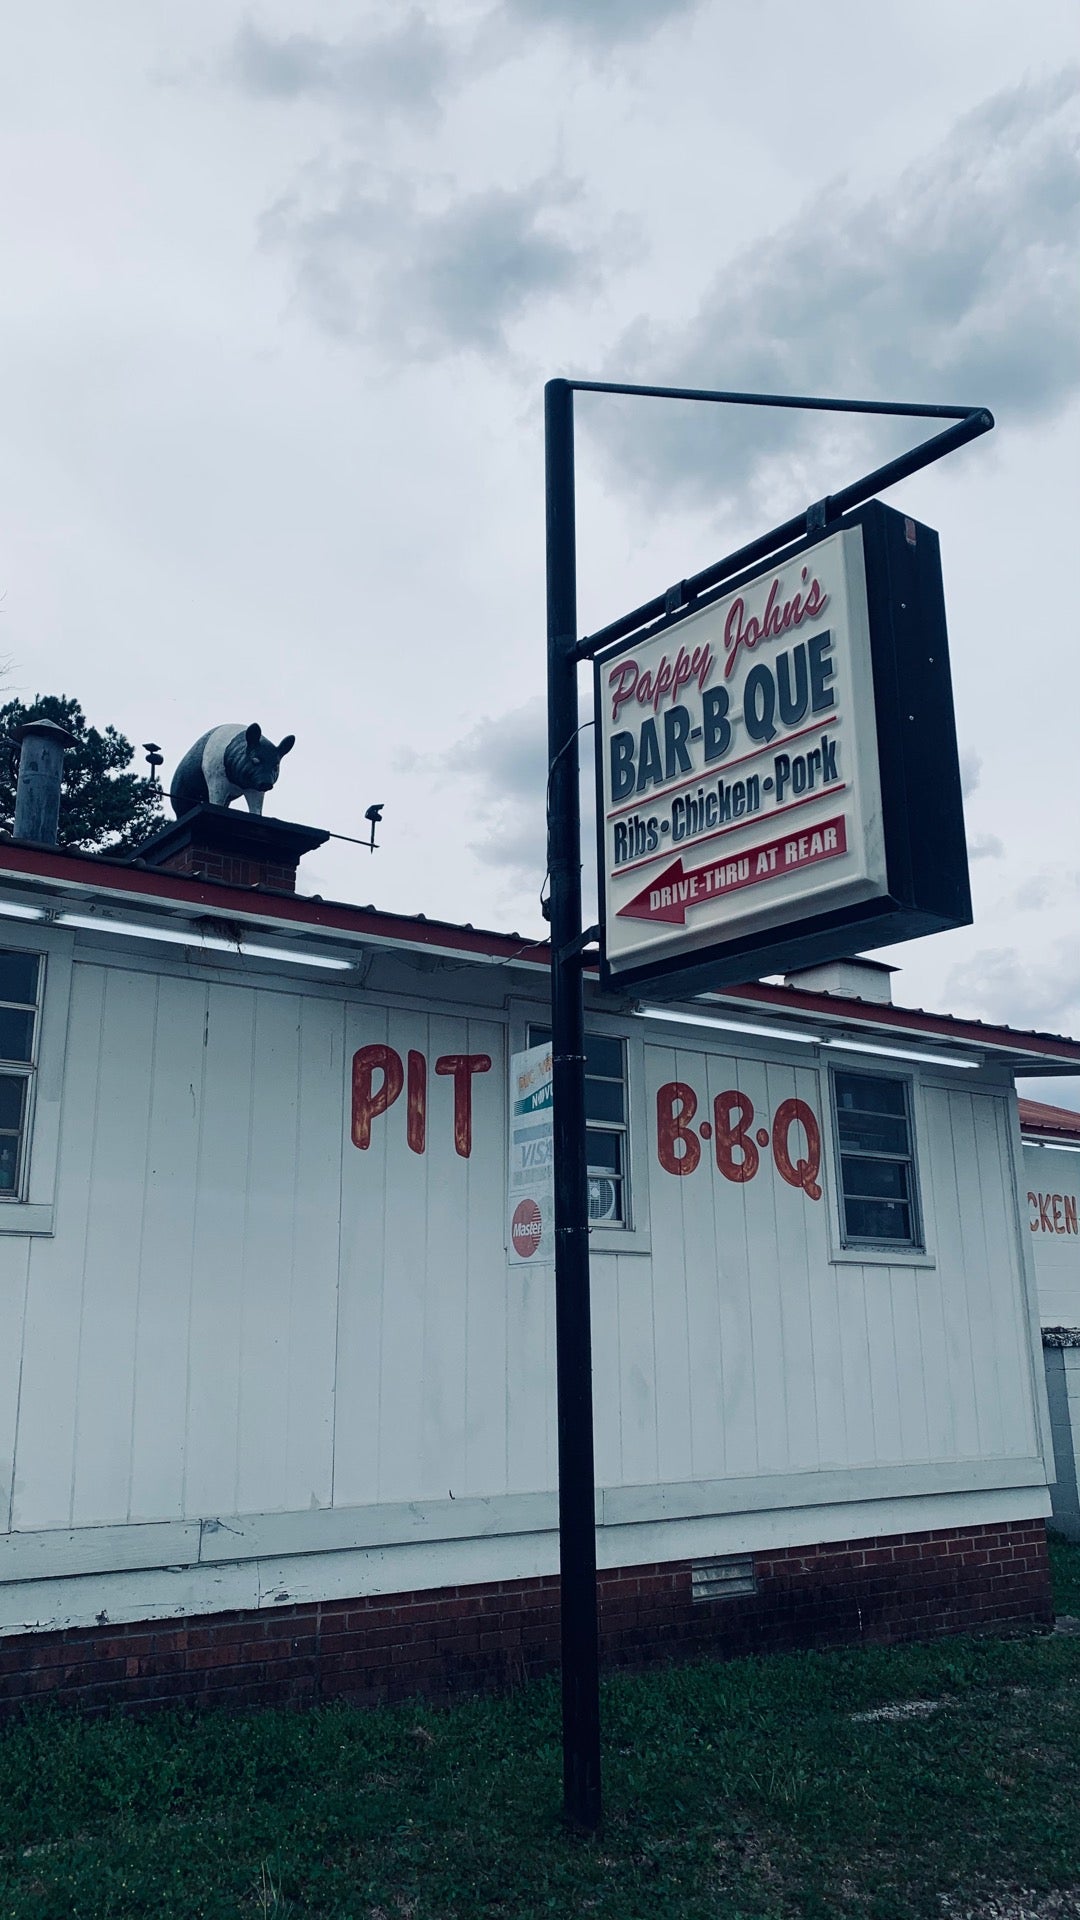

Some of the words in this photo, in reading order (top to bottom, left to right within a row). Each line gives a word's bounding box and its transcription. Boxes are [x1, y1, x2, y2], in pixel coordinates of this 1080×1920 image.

[609, 642, 713, 720] Pappy
[724, 566, 828, 678] John's
[649, 858, 750, 912] DRIVE-THRU
[755, 847, 778, 876] AT
[785, 827, 838, 866] REAR
[350, 1043, 492, 1160] PIT
